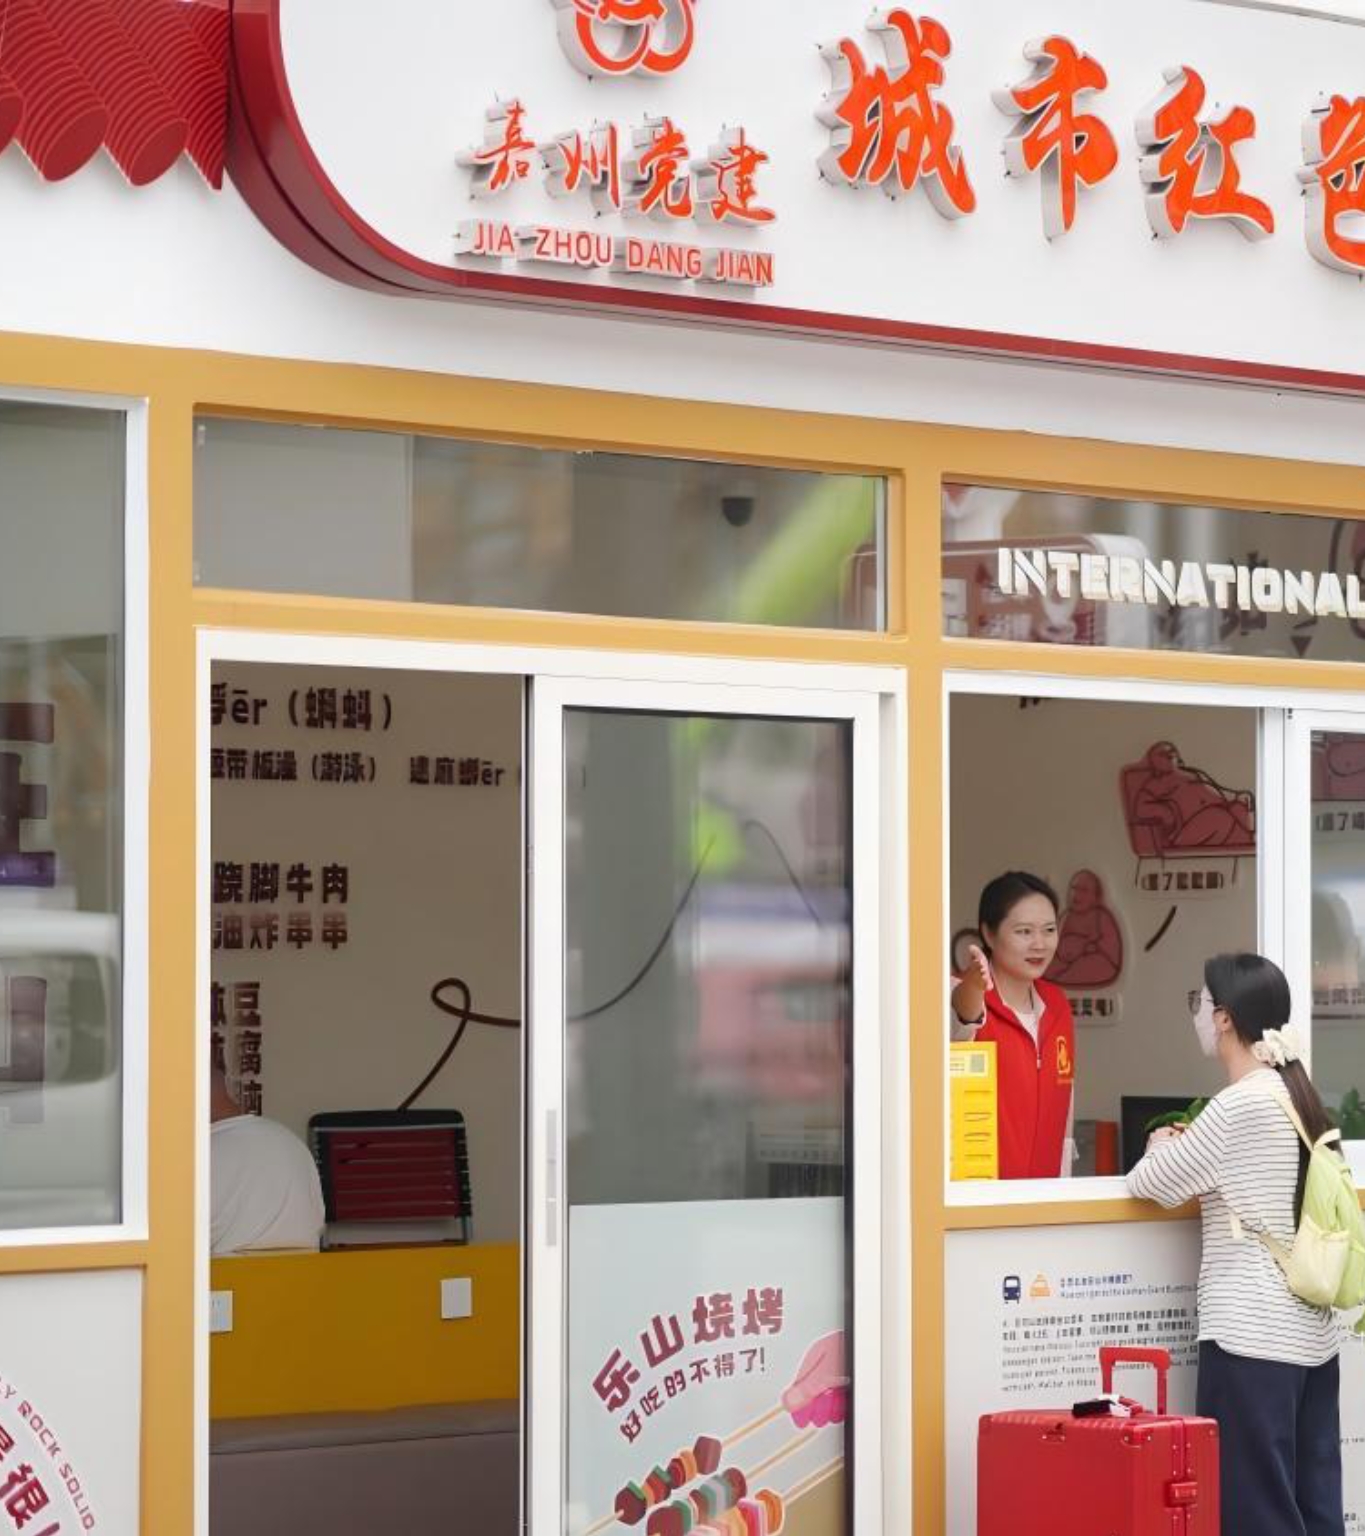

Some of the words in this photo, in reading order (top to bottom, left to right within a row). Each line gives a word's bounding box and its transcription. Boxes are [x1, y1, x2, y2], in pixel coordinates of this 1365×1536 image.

[474, 98, 776, 221] 嘉州党建
[473, 222, 515, 251] JIA
[535, 228, 613, 264] ZHOU
[627, 239, 701, 277] DANG
[715, 251, 775, 284] JIAN
[213, 861, 348, 904] 跷脚牛肉
[592, 1287, 785, 1413] 乐山烧烤
[619, 1346, 766, 1443] 好吃的不得了！
[18, 1400, 61, 1457] ROCK
[58, 1463, 95, 1530] SOLID
